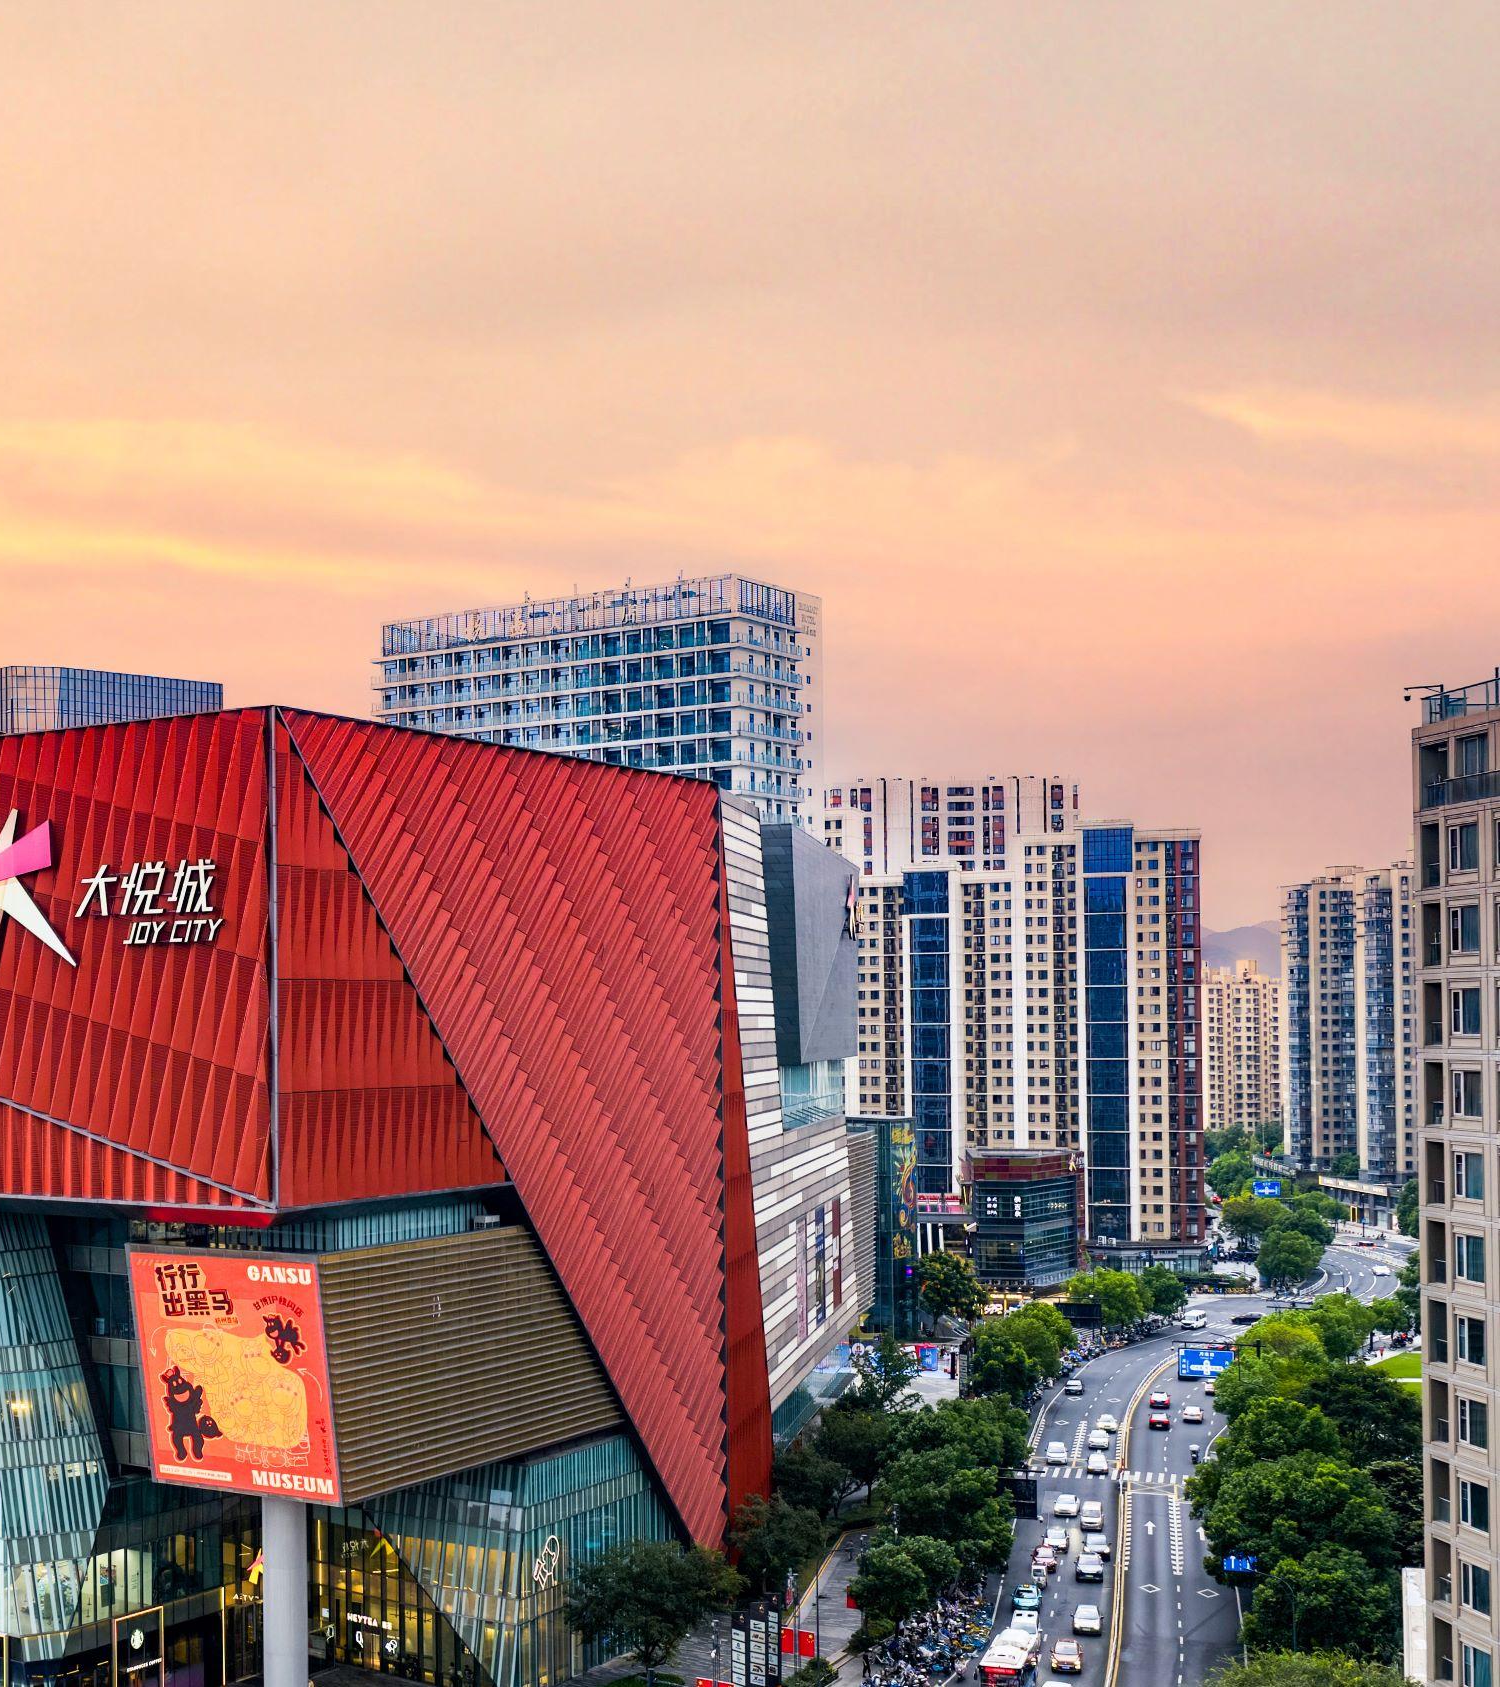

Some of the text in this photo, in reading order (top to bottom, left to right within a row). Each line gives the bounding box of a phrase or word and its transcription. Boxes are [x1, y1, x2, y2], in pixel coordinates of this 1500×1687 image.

[75, 859, 216, 918] 大悦城
[123, 919, 224, 945] JOY CITY
[155, 1264, 200, 1291] 行行
[247, 1265, 311, 1285] GANSU
[162, 1288, 234, 1317] 出黑马
[252, 1469, 334, 1495] MUSEUM
[346, 1612, 378, 1627] HEYTEA
